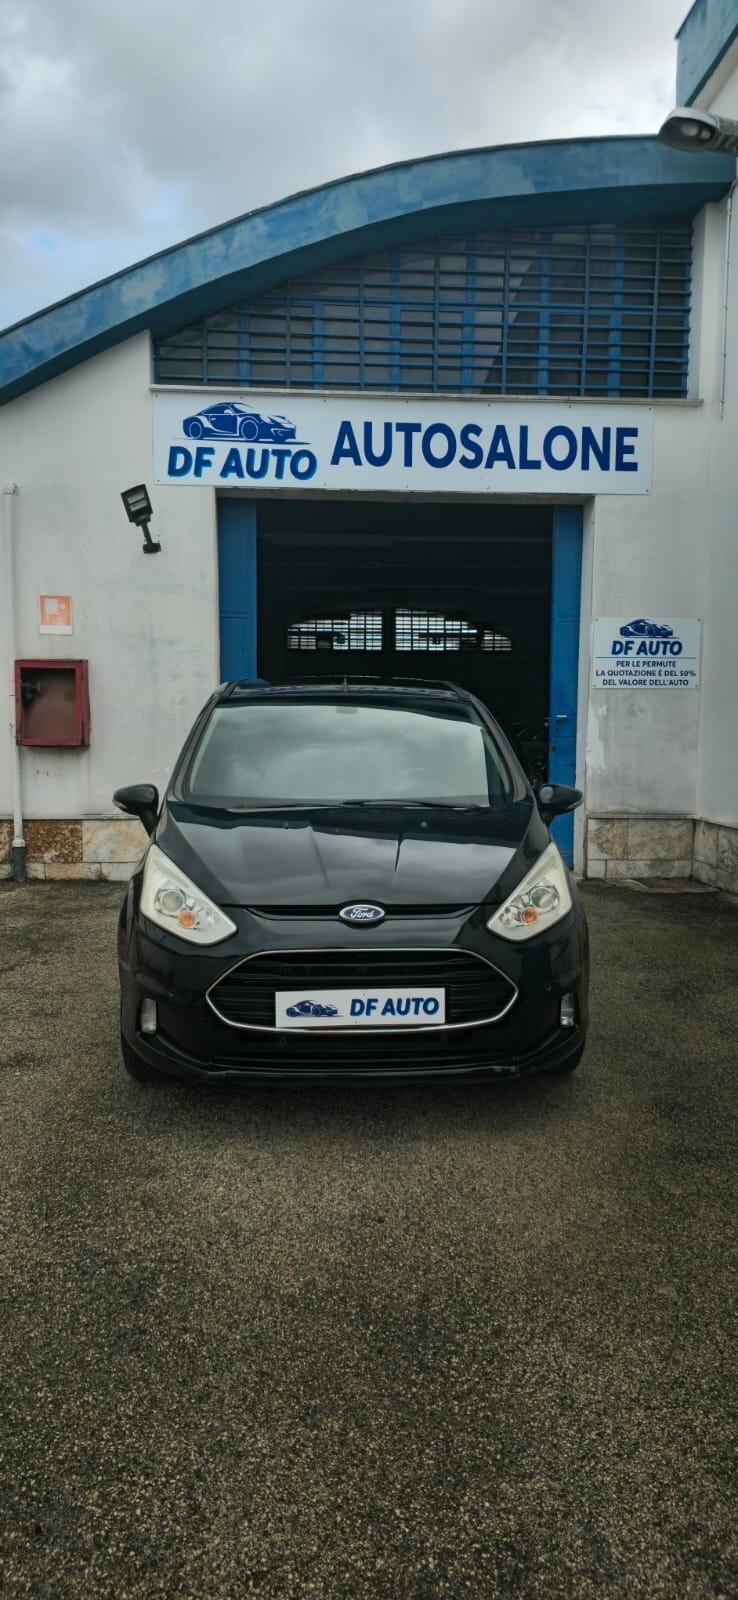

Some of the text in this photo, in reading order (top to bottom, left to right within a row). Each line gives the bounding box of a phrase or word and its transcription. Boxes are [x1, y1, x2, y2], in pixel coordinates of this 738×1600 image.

[330, 420, 639, 472] AUTOSALONE
[167, 445, 318, 481] DF AUTO
[611, 640, 683, 655] DF AUTO
[616, 660, 677, 668] PER LE PERMUTE
[351, 907, 374, 918] Ford
[350, 997, 440, 1016] DF AUTO
